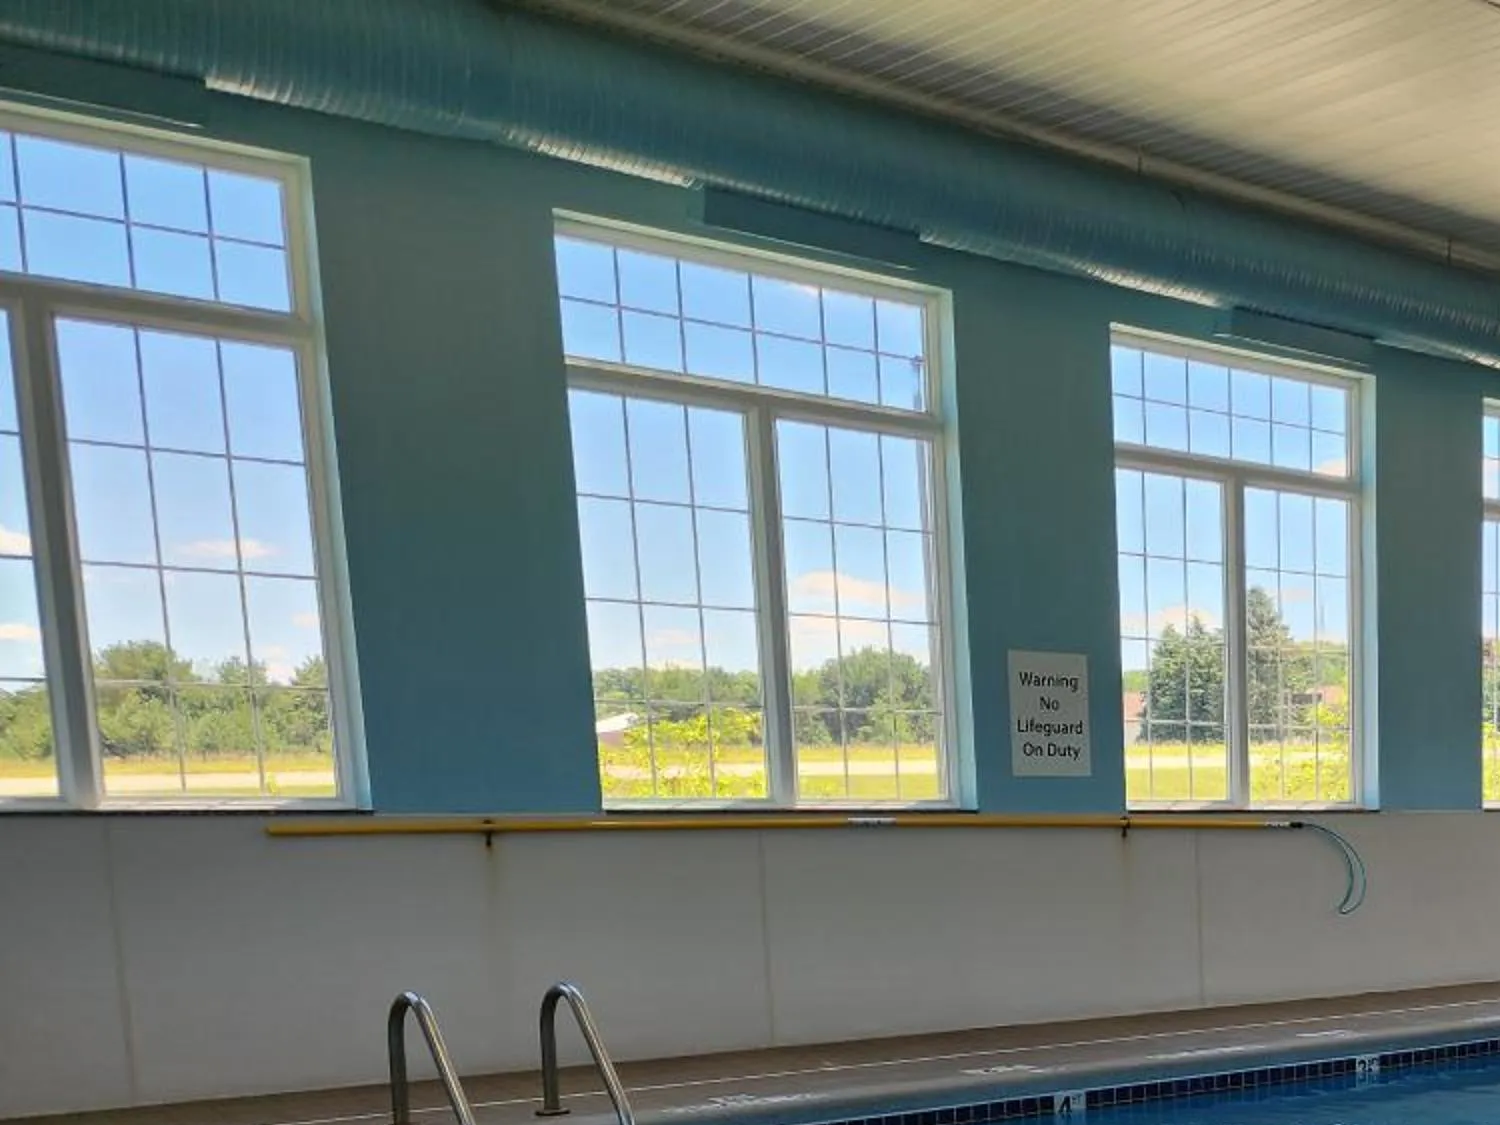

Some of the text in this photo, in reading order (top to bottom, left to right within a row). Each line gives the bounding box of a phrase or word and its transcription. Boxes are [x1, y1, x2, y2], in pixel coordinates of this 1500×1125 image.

[1019, 671, 1079, 693] Warning
[1040, 696, 1060, 711] No
[1017, 718, 1083, 736] Lifeguard
[1023, 741, 1081, 761] On Duty
